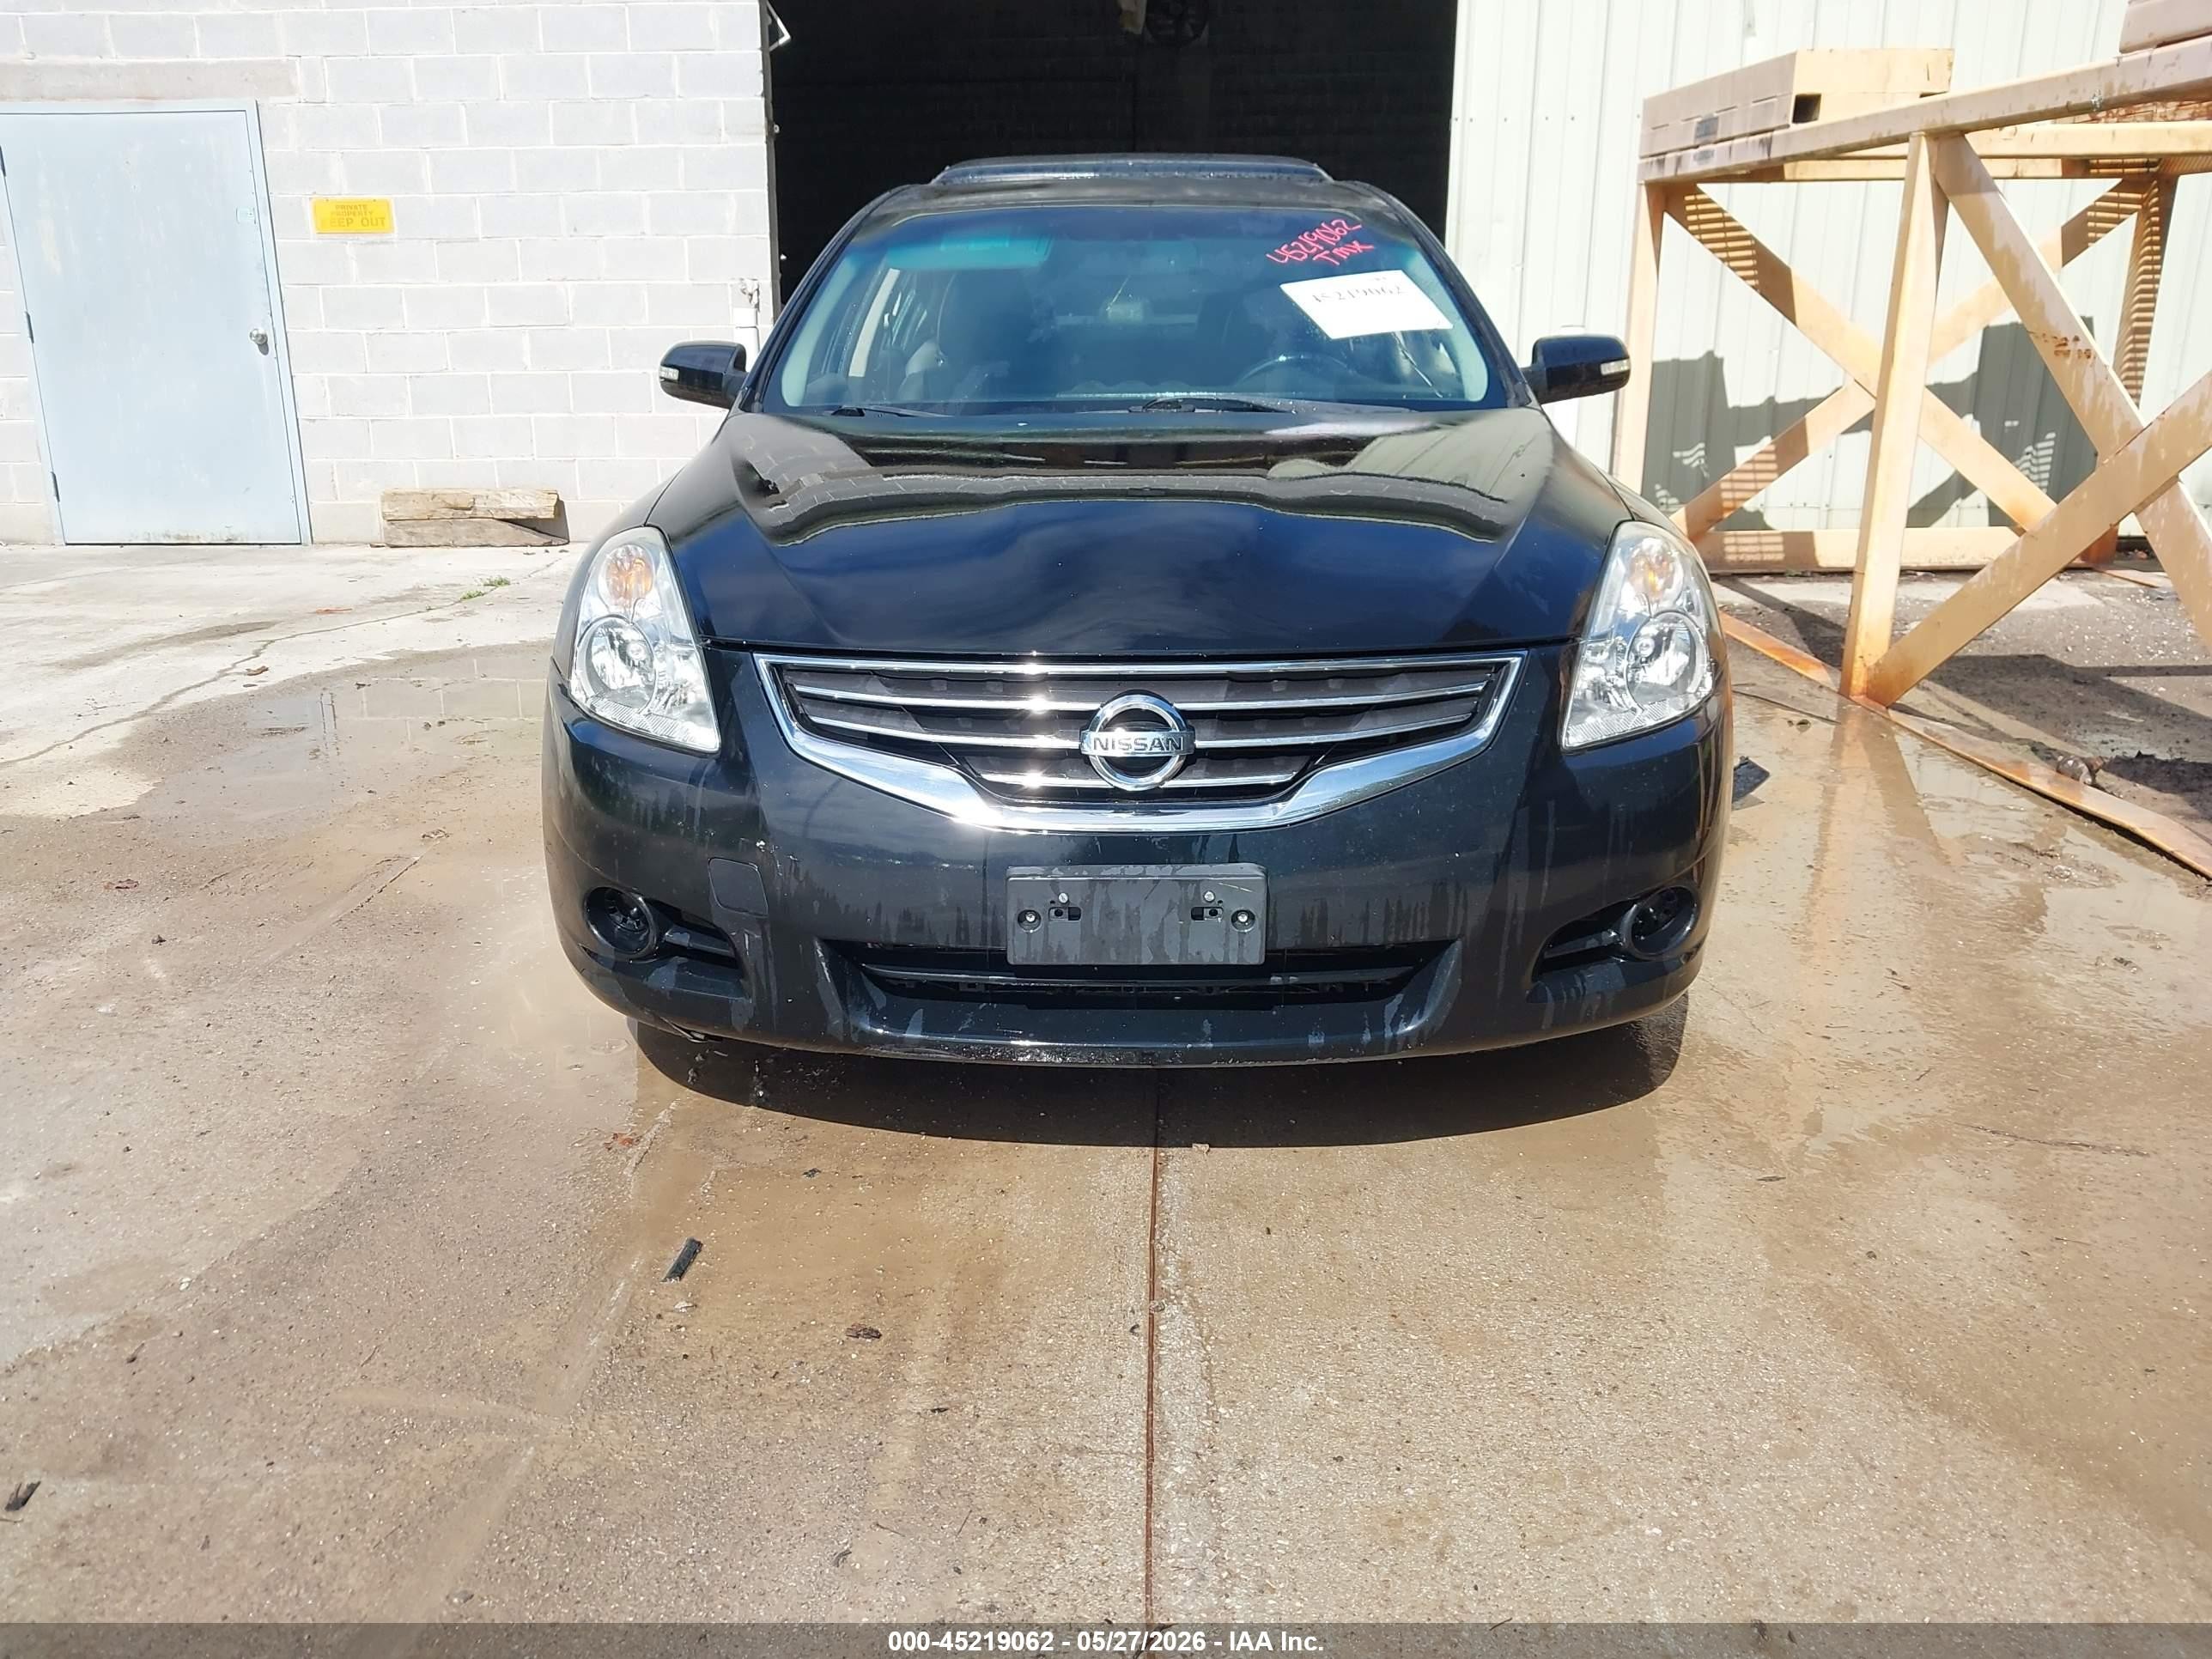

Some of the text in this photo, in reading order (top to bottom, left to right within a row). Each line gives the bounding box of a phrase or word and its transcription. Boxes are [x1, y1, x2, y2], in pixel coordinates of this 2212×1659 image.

[321, 217, 386, 227] EEP OUT
[1266, 219, 1363, 264] 45219062
[1093, 736, 1184, 752] NISSAN
